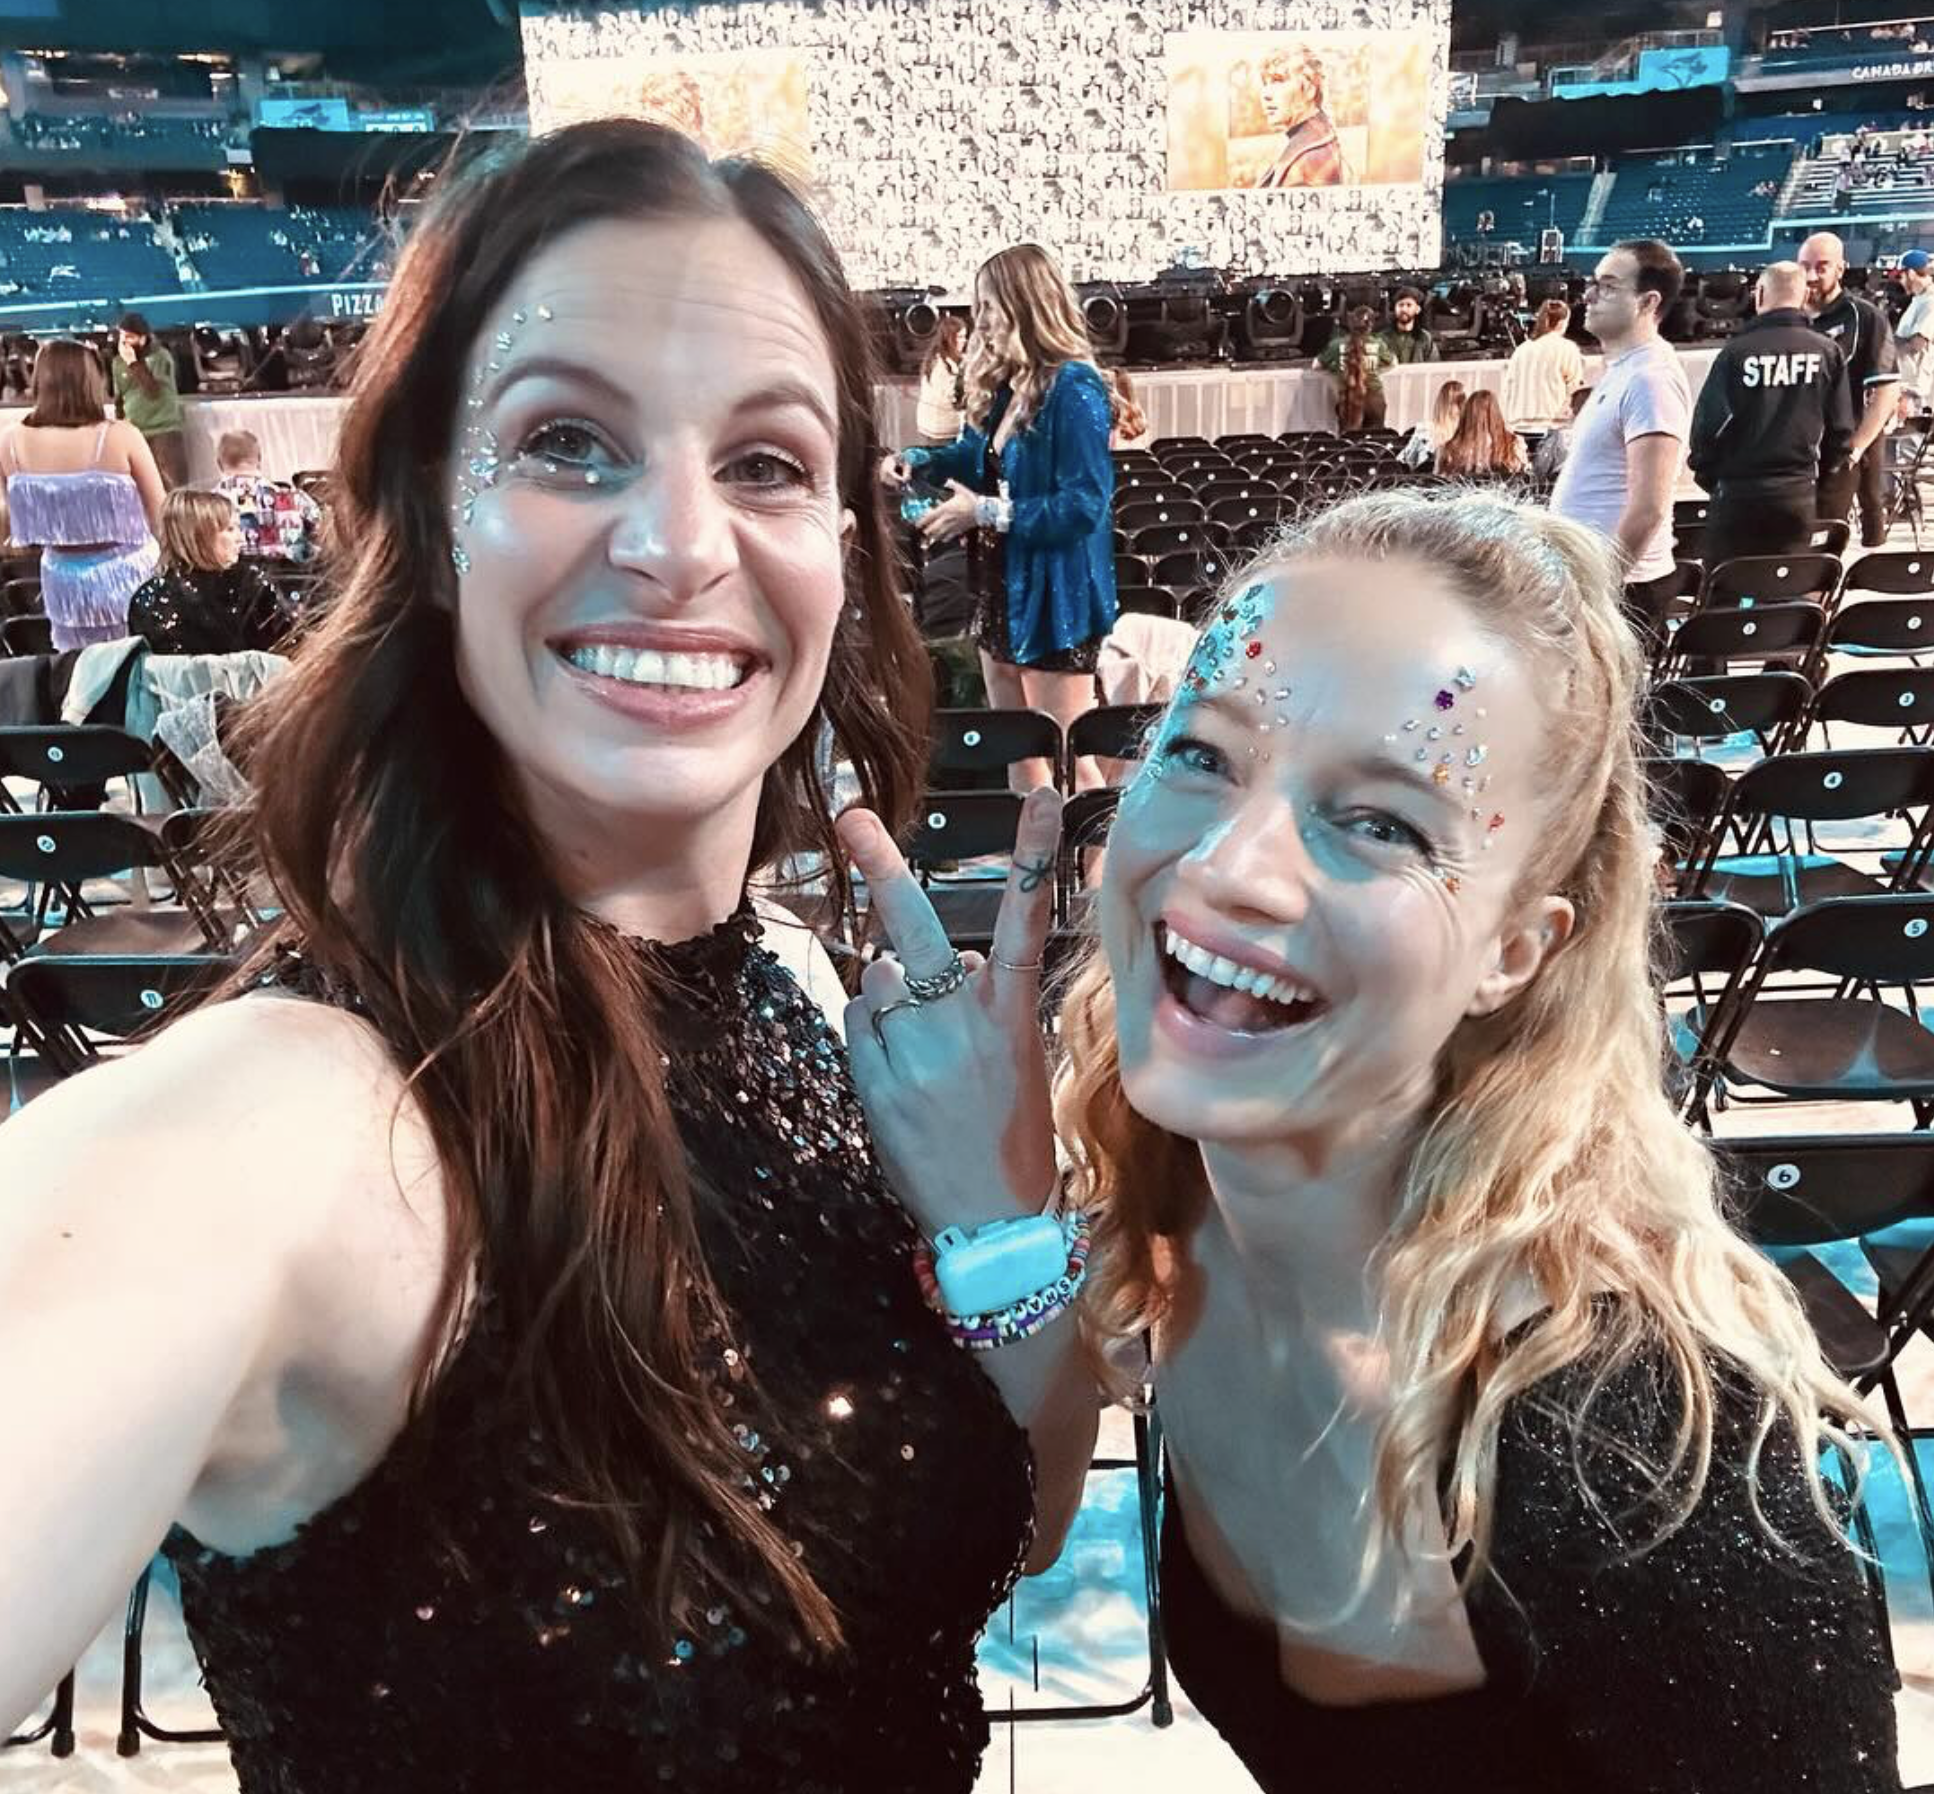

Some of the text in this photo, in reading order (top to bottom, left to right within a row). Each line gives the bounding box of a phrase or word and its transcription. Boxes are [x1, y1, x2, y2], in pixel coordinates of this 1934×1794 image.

[1852, 60, 1934, 79] CANADA DR
[1743, 353, 1820, 387] STAFF
[1778, 1168, 1792, 1183] 6
[999, 1279, 1071, 1320] SHAK
